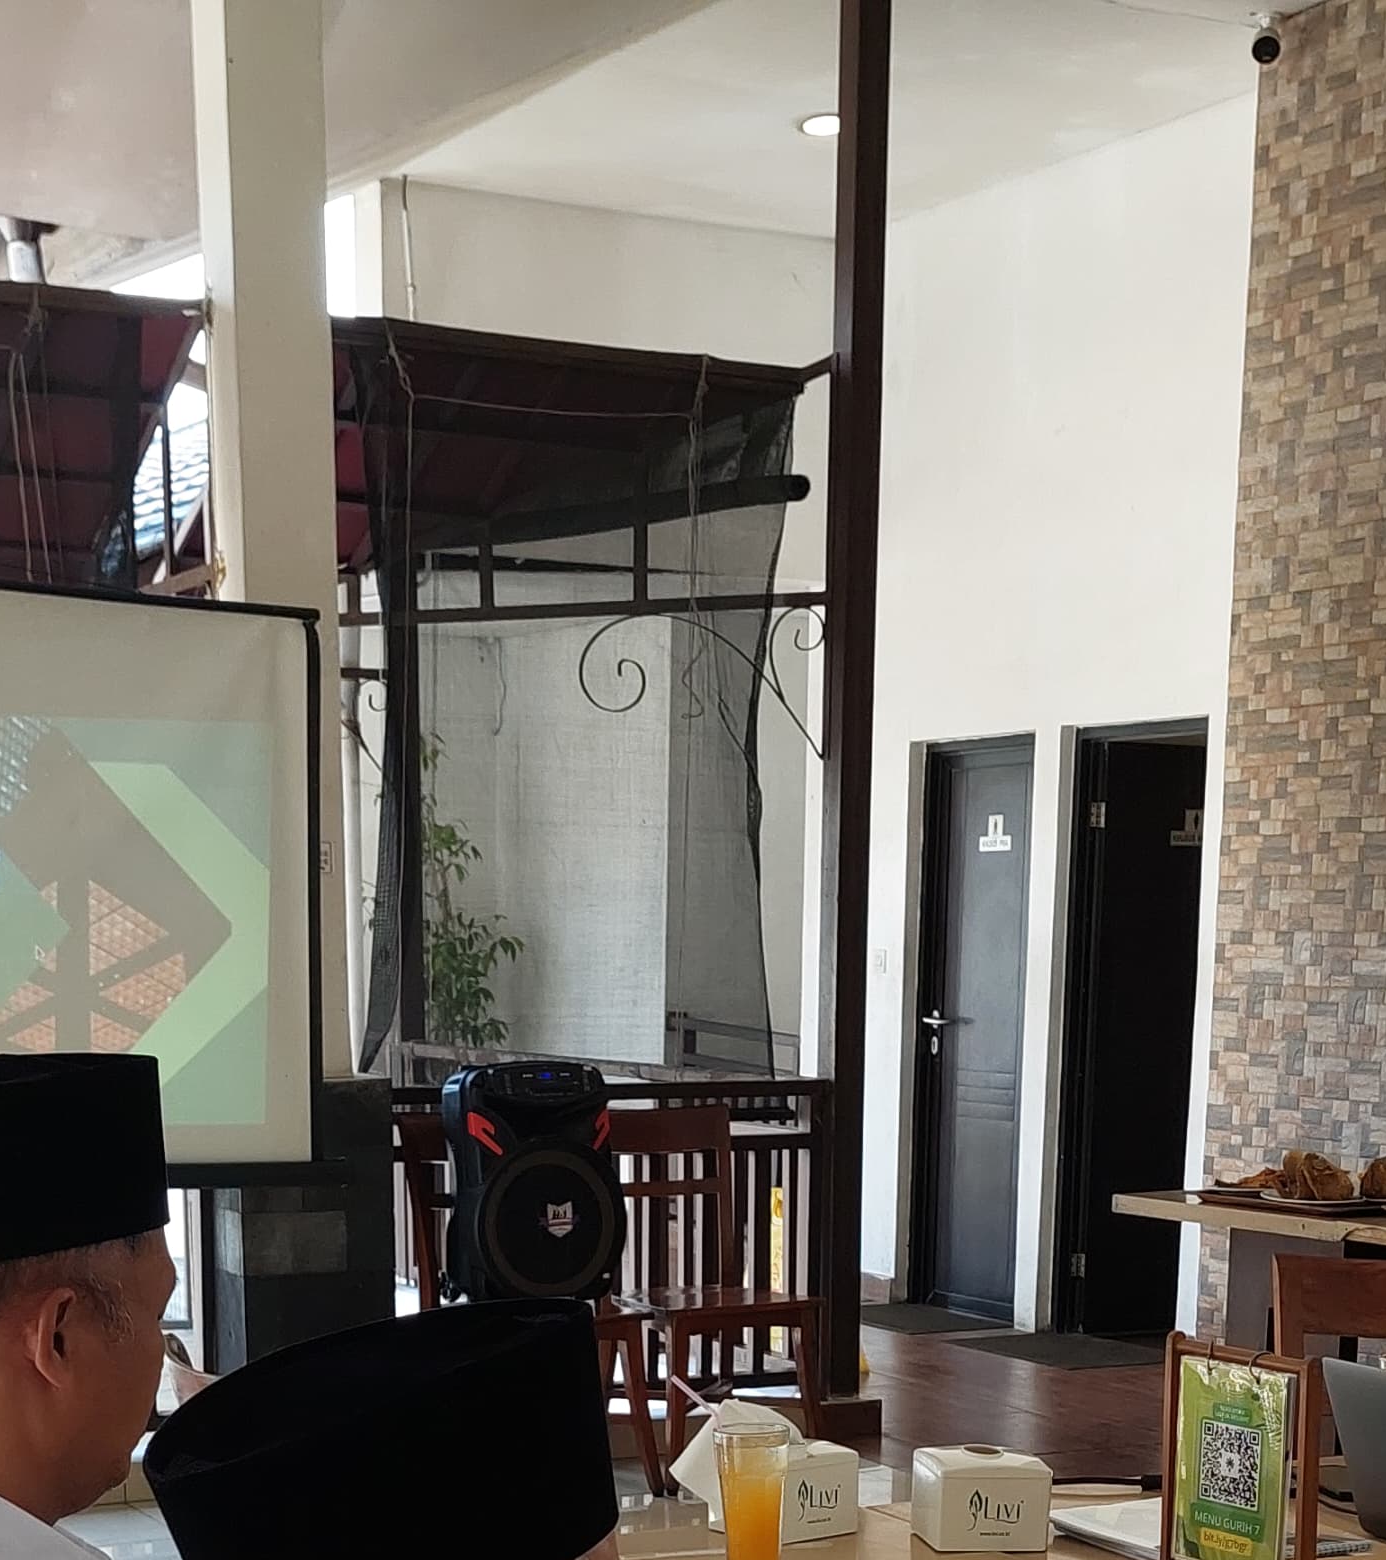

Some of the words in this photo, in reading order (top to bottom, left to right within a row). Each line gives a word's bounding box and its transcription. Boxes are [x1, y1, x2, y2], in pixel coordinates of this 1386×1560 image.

[1194, 1510, 1221, 1526] MENU
[1223, 1517, 1252, 1534] GURIH
[1252, 1525, 1260, 1535] 7
